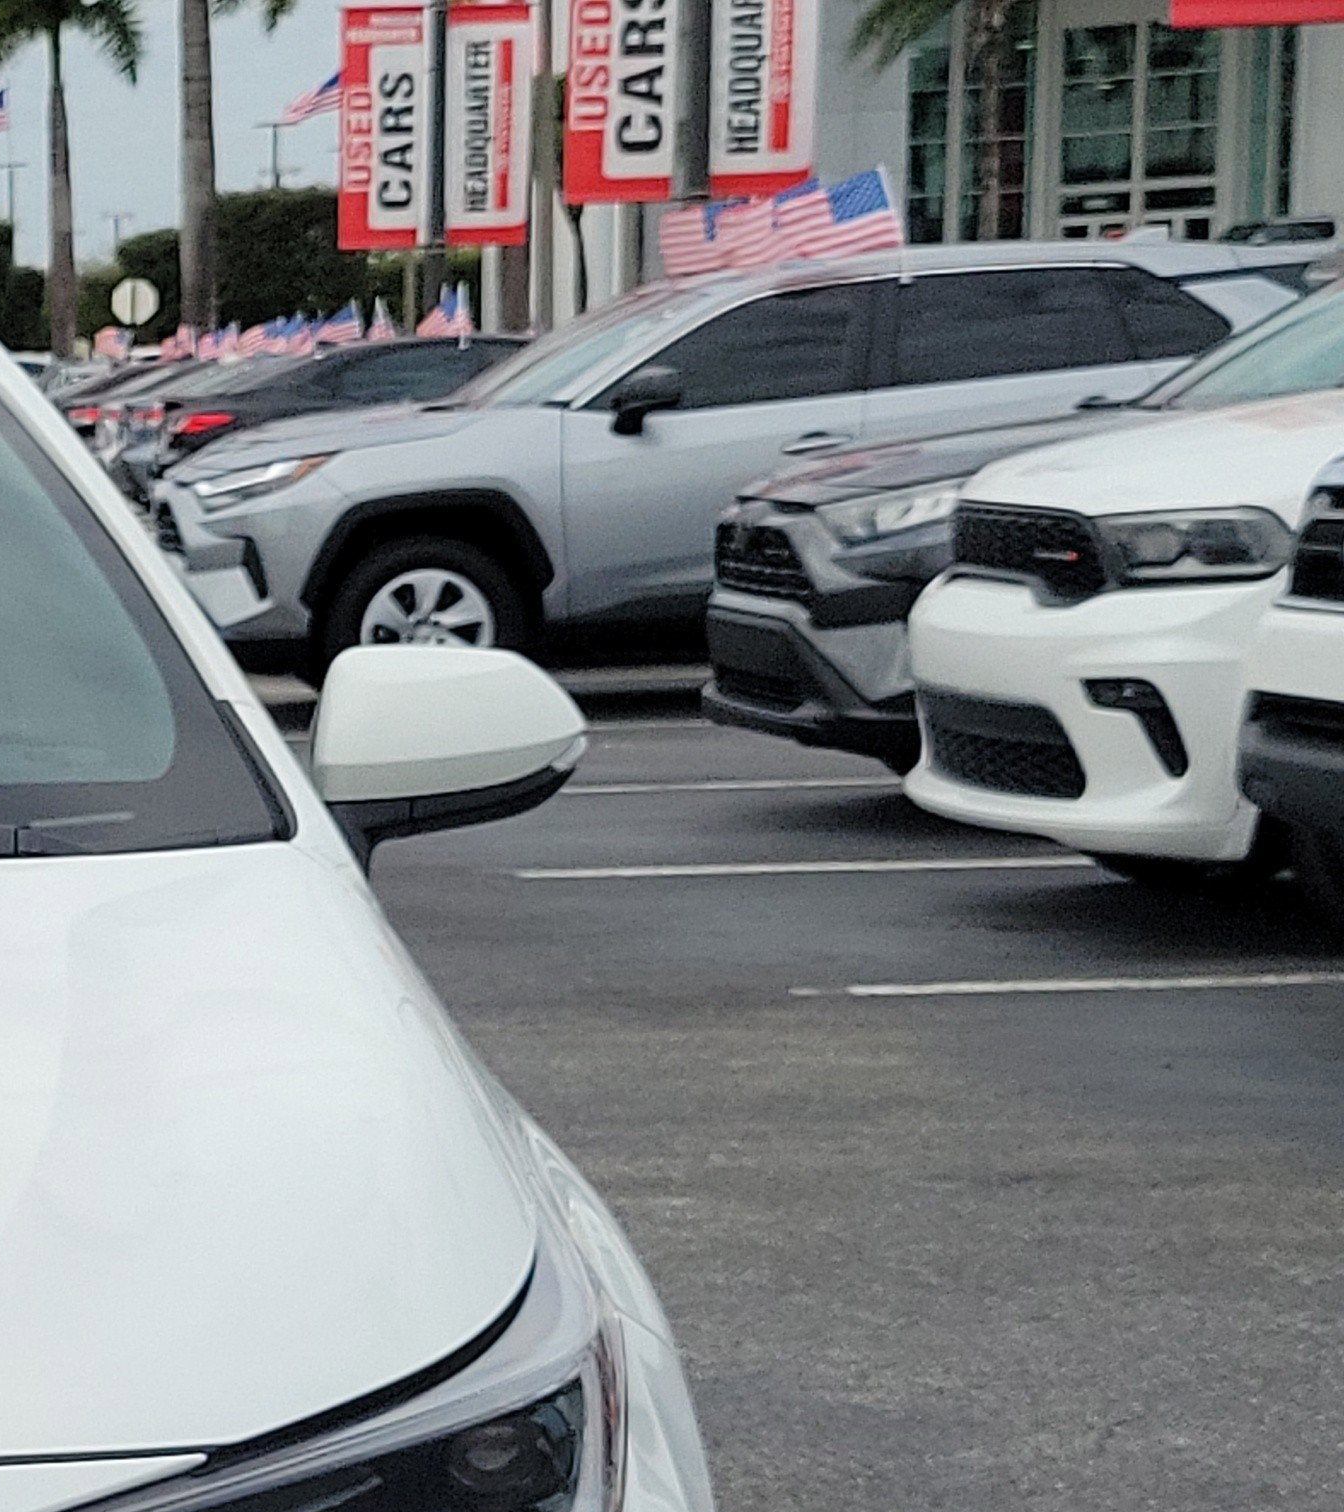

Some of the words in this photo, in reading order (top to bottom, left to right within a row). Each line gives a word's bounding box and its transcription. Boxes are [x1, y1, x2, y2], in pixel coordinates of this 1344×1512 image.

[465, 40, 491, 212] HEADQUARTER
[575, 1, 611, 121] USED
[620, 0, 666, 152] CAR
[348, 91, 371, 186] USED
[379, 72, 414, 209] CARS
